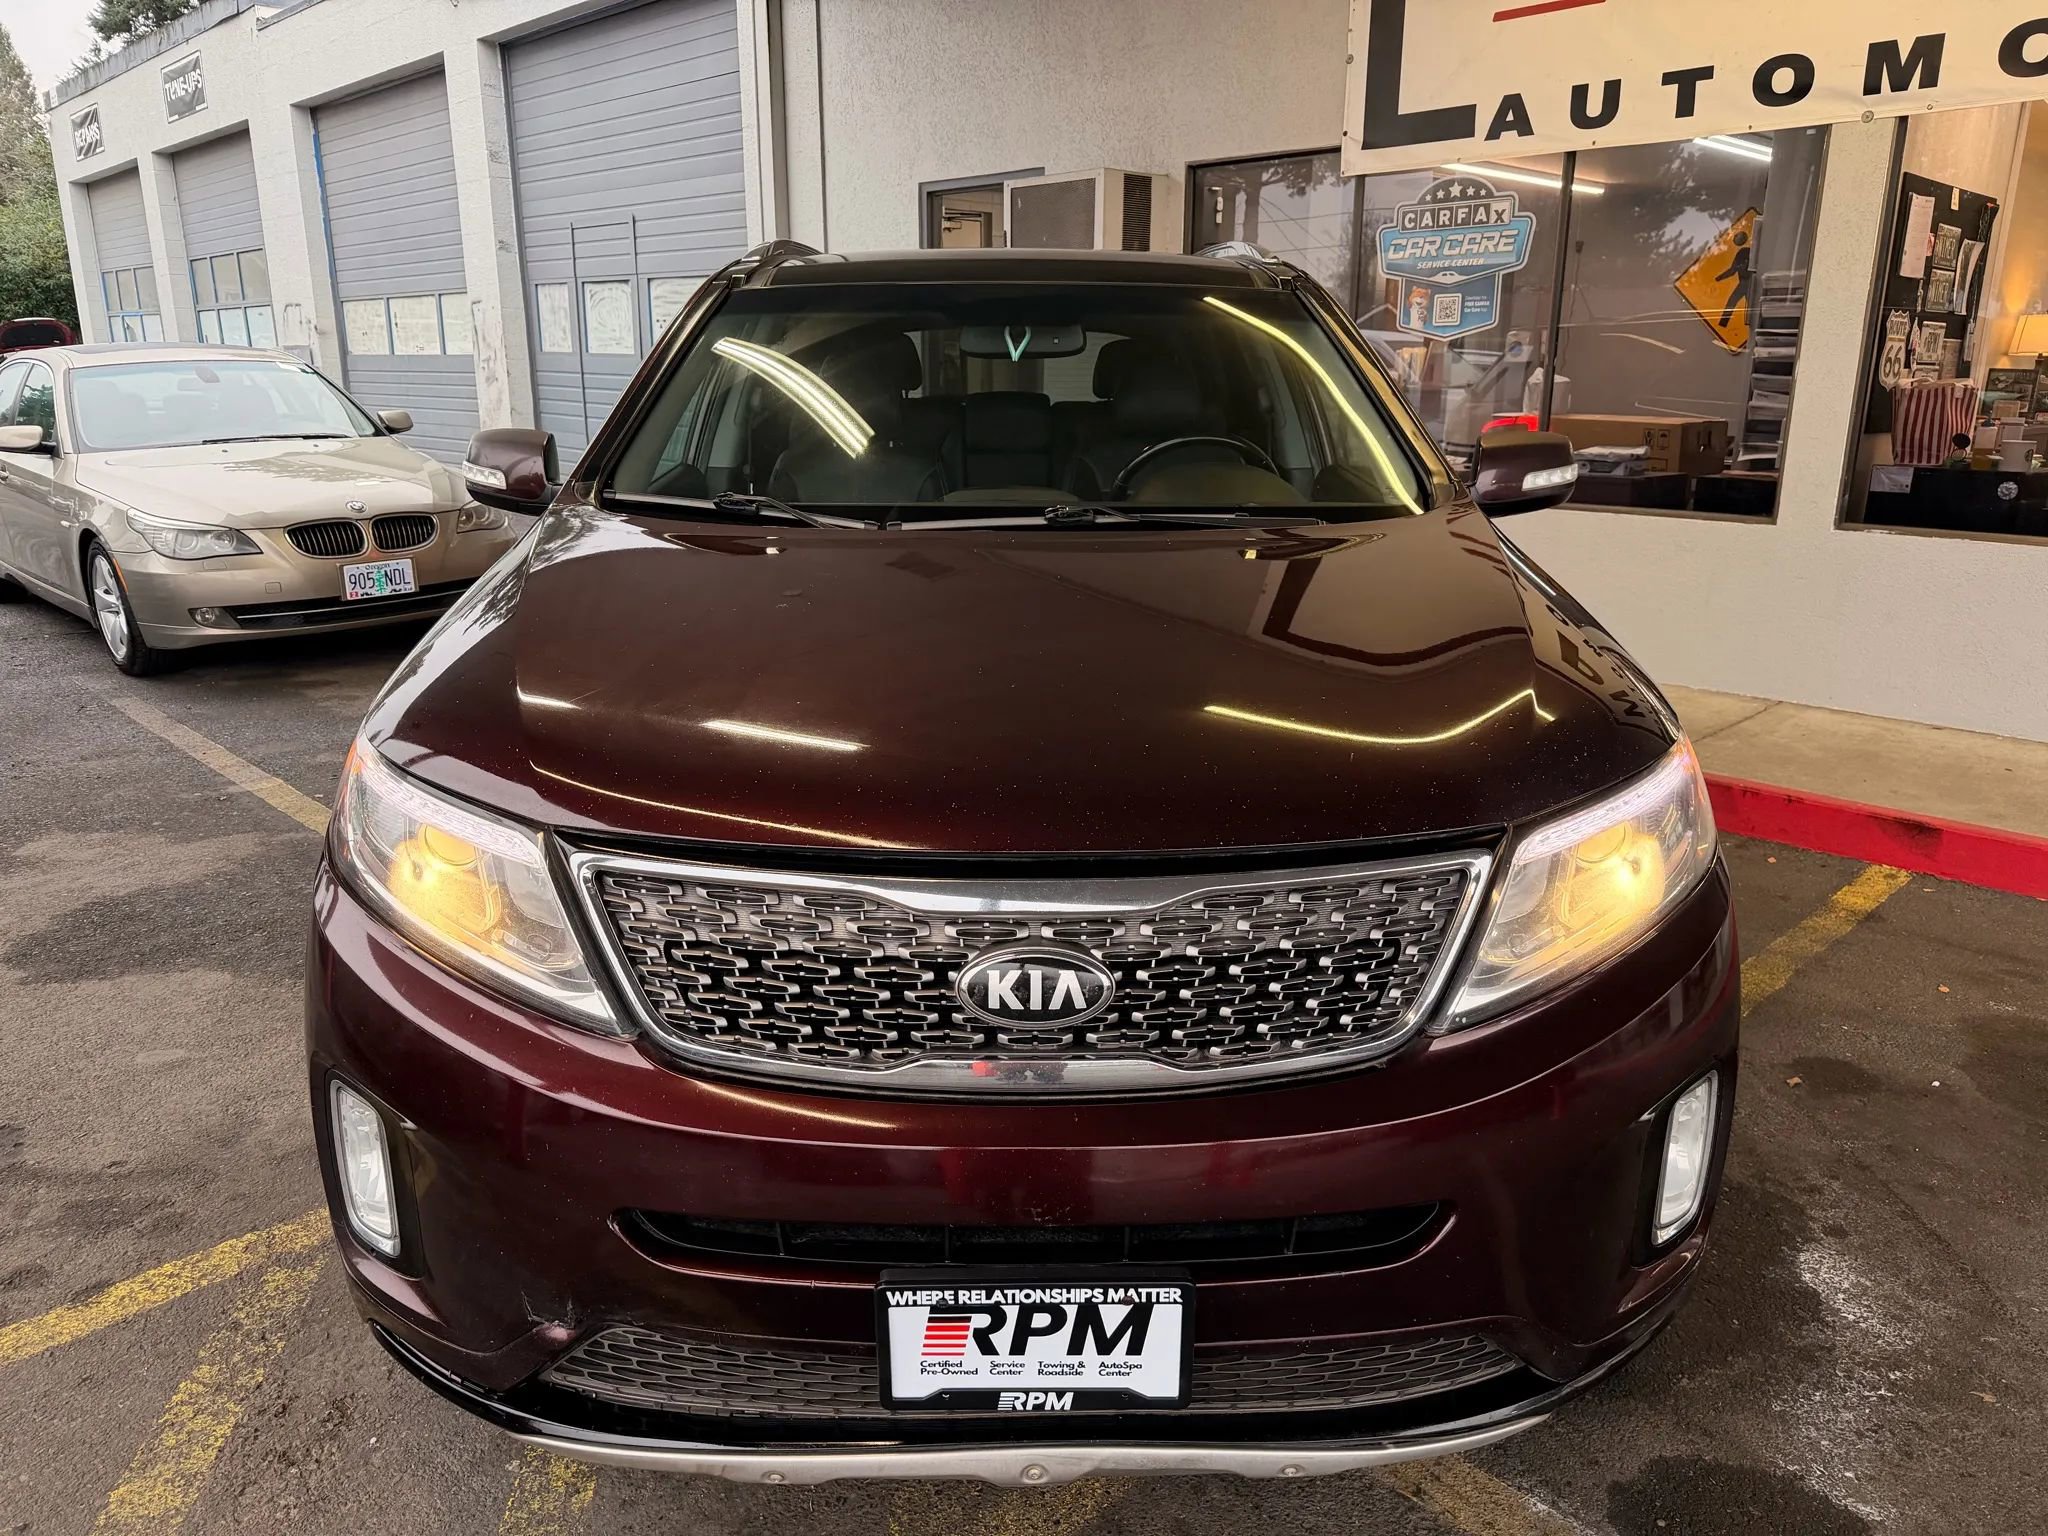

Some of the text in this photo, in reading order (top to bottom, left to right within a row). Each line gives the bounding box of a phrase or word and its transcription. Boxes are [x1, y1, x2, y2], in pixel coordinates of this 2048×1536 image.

[1404, 206, 1507, 229] CARFAX
[1387, 229, 1519, 260] CAR CARE
[1416, 257, 1485, 270] SERVICE CENTER
[1888, 317, 1908, 337] ROUTE
[1883, 344, 1903, 379] 66
[349, 568, 411, 591] 905 NDL
[986, 969, 1087, 1010] KIA
[886, 1287, 1183, 1306] WHERE RELATIONSHIPS MATTER
[921, 1304, 1155, 1356] RPM
[920, 1360, 963, 1368] Certified
[920, 1367, 979, 1376] Pre-Owned
[989, 1360, 1026, 1368] Service
[989, 1367, 1024, 1376] Center
[1037, 1360, 1086, 1370] Towing &
[1098, 1360, 1143, 1370] AutoSpa
[1037, 1368, 1084, 1377] Roadside
[1098, 1368, 1133, 1377] Center
[997, 1391, 1075, 1411] RPM
